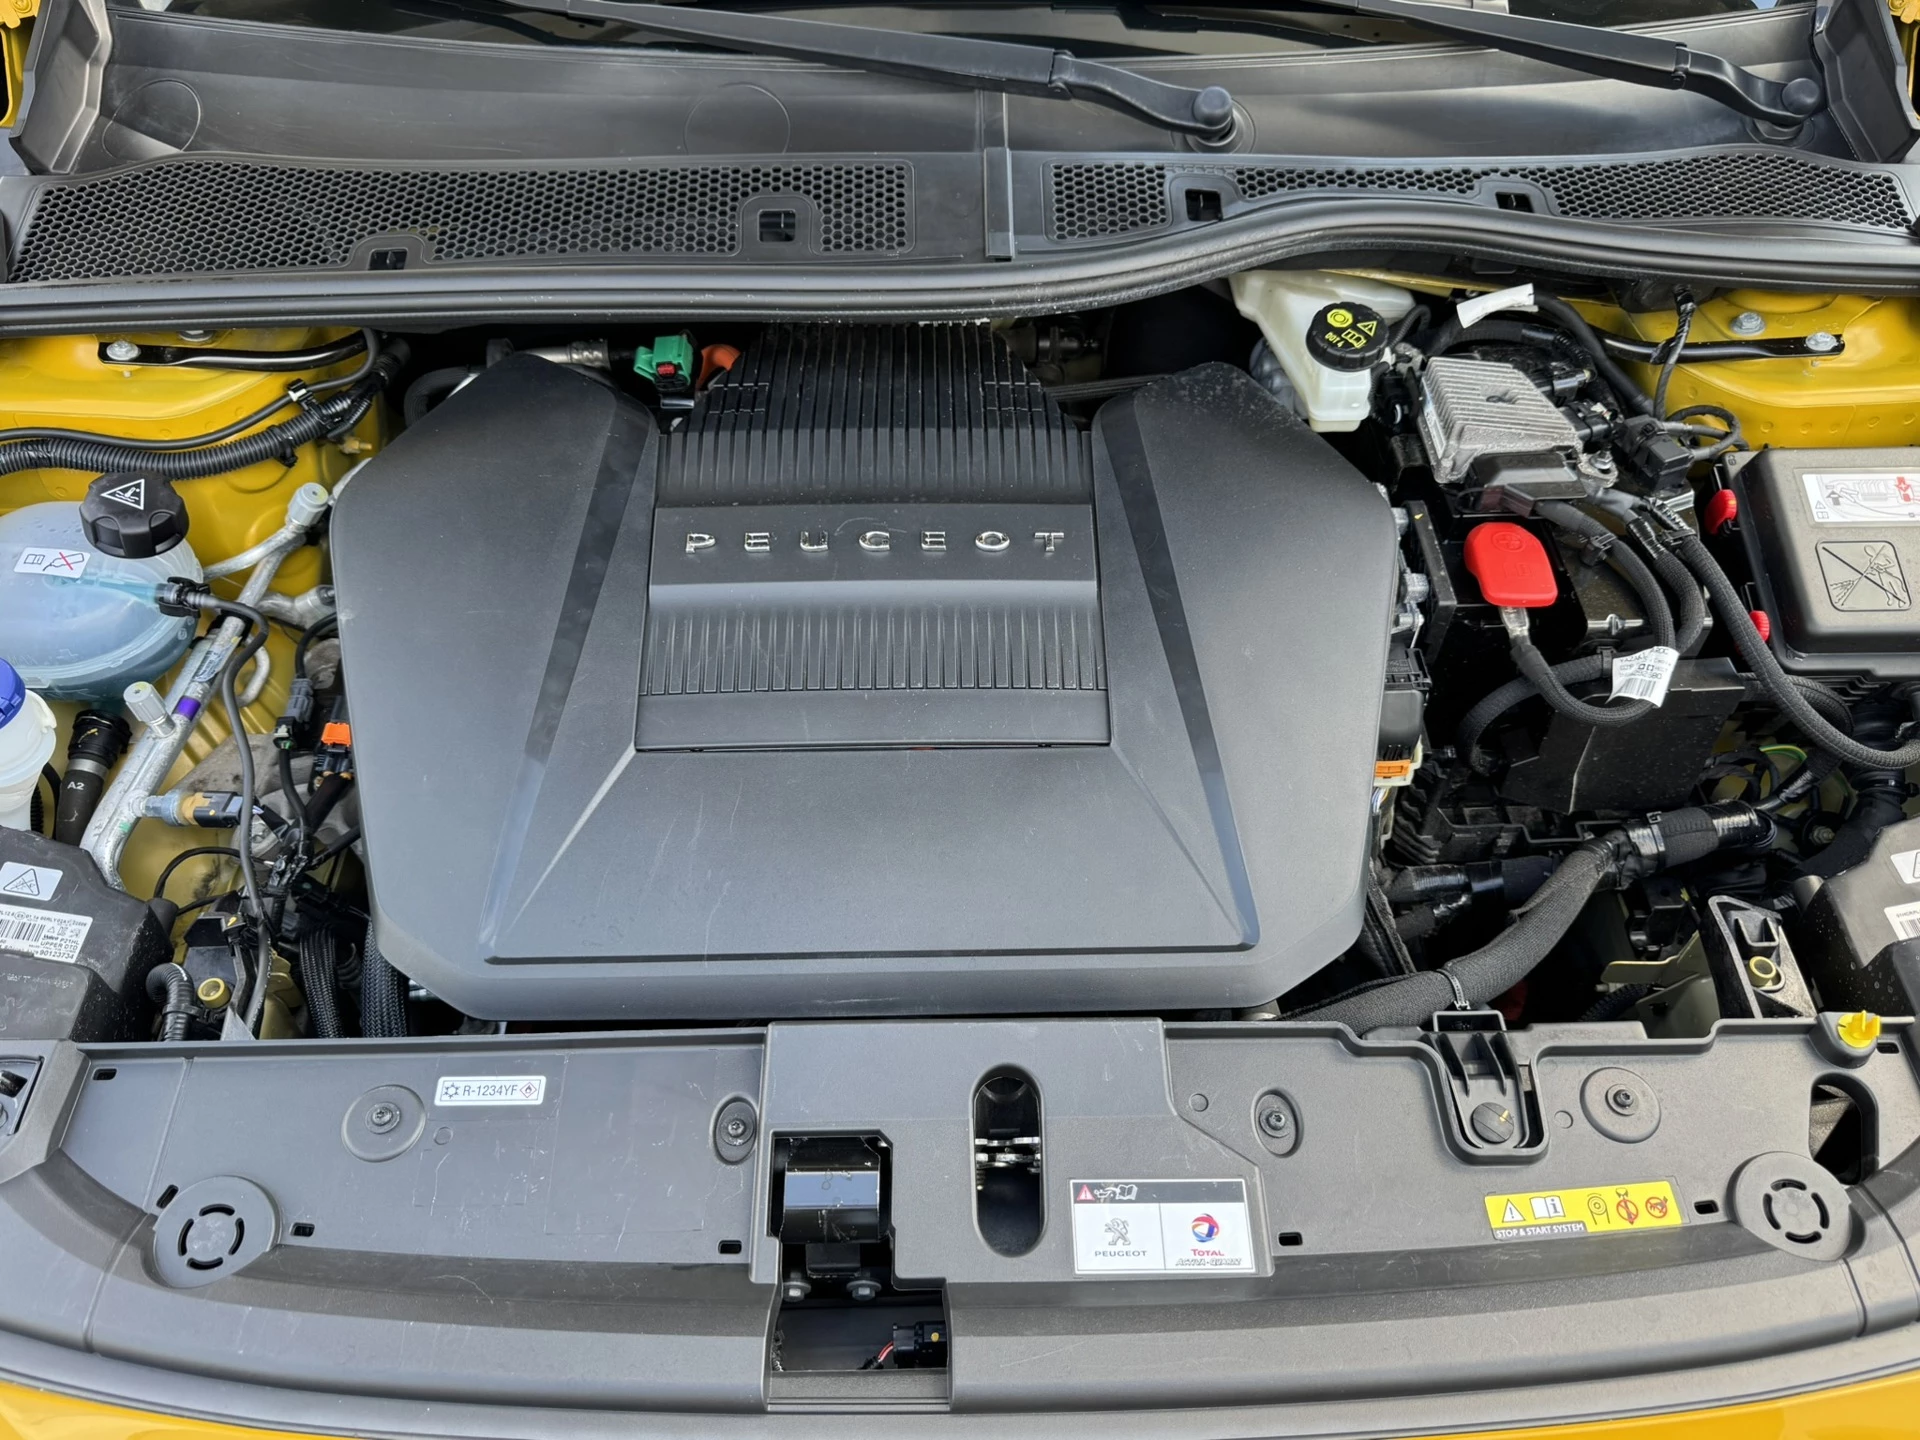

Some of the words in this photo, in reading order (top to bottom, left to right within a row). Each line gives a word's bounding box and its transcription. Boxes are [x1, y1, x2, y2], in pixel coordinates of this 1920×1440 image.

[685, 531, 1065, 553] PEUGEOT
[67, 781, 85, 790] A2
[40, 950, 74, 959] 90123734
[462, 1084, 518, 1096] R-1234YF
[1496, 1229, 1518, 1238] STOP
[1519, 1228, 1526, 1236] &
[1527, 1225, 1552, 1235] START
[1552, 1222, 1584, 1233] SYSTEM
[1190, 1248, 1225, 1256] TOTAL
